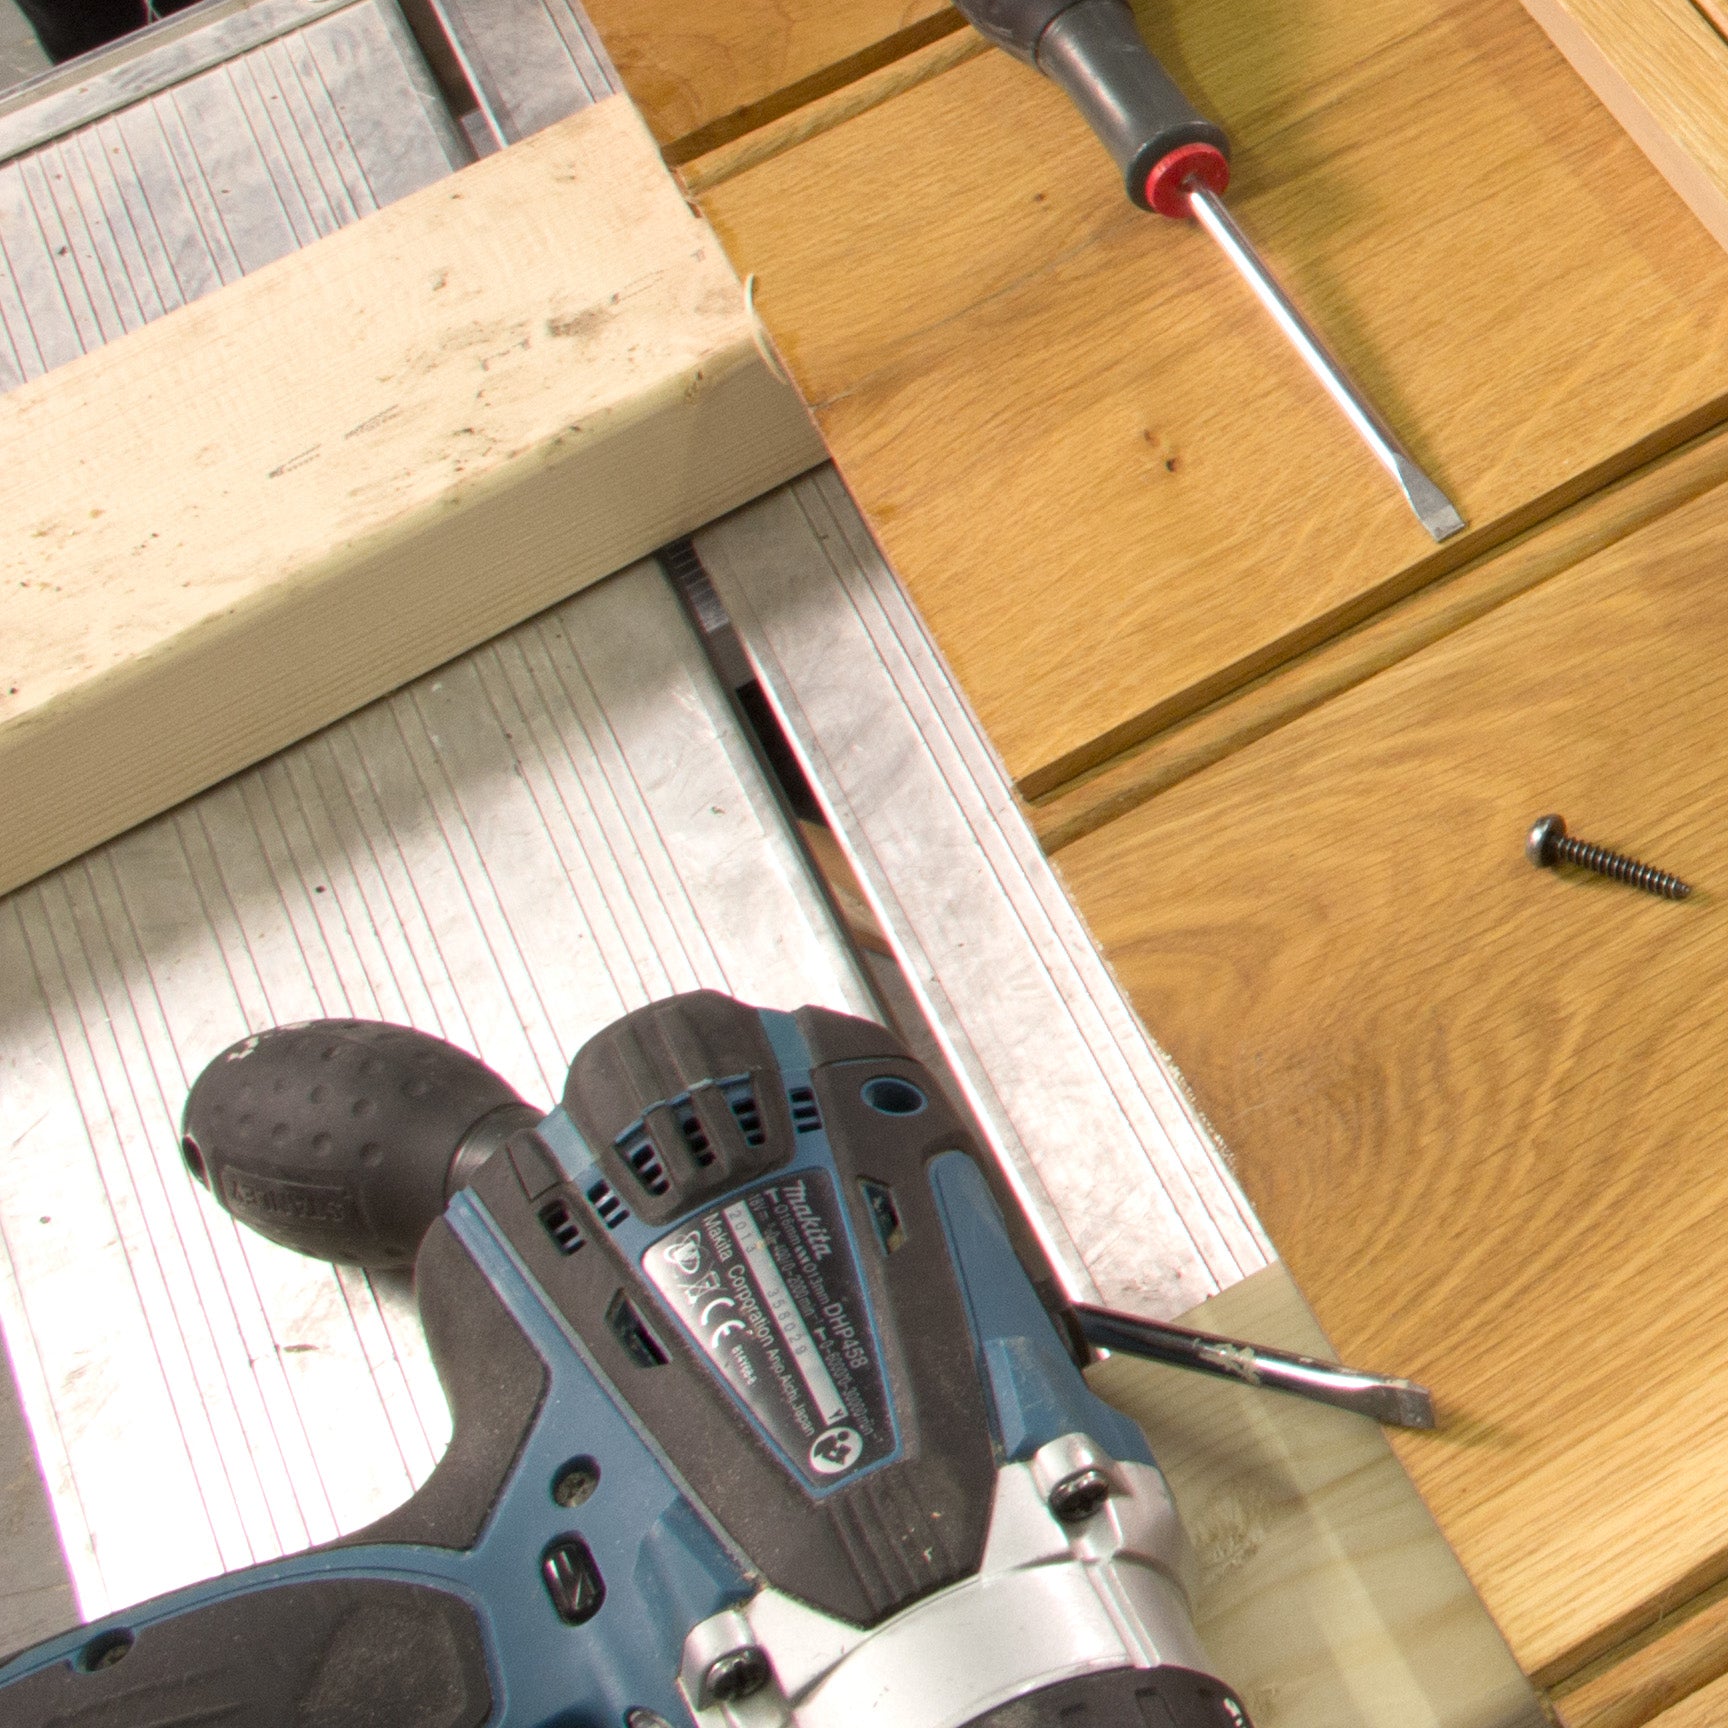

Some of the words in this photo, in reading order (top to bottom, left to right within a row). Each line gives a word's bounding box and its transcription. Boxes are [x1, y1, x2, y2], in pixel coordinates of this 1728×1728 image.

[729, 1210, 756, 1254] 2013
[702, 1213, 732, 1262] Makita
[728, 1264, 775, 1350] Corporation
[826, 1301, 869, 1369] DHP458
